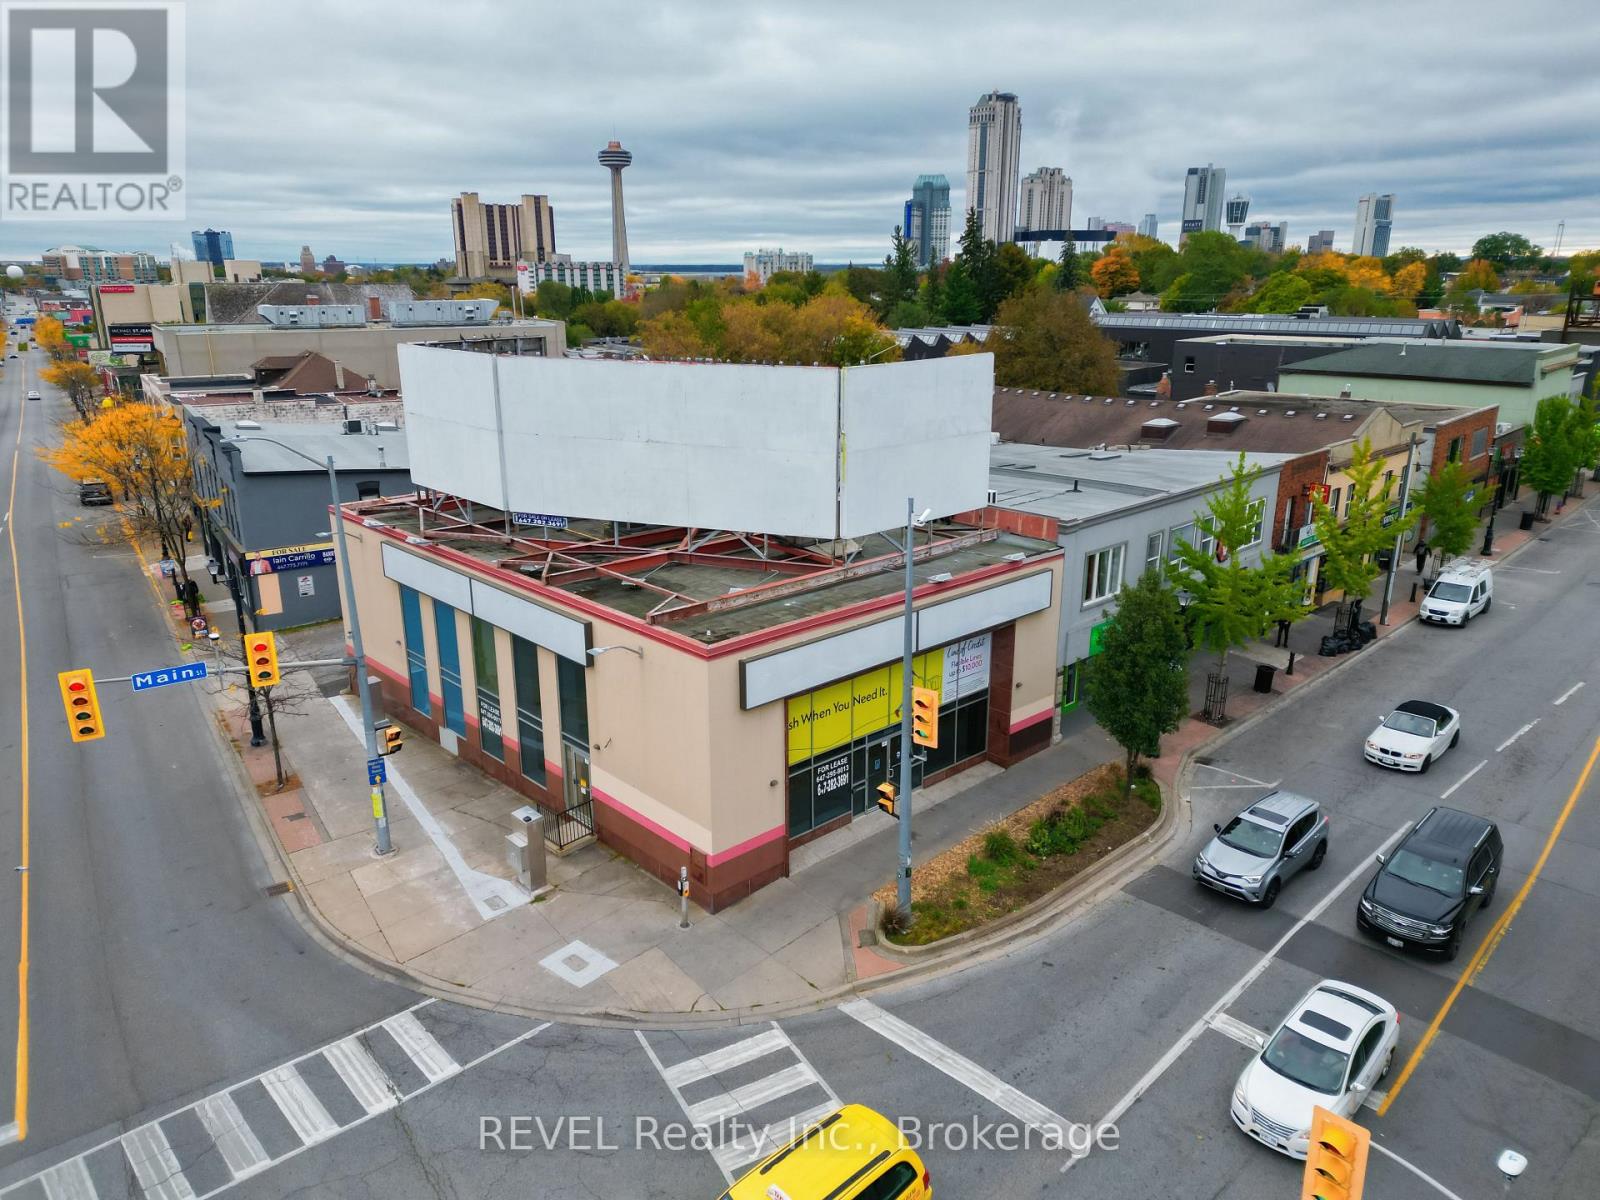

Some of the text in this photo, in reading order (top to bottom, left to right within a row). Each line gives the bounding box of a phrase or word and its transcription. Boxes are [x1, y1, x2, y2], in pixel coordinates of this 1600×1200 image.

[288, 552, 316, 561] Carrillo
[136, 669, 194, 687] Main
[801, 708, 831, 724] When
[833, 701, 850, 713] You
[852, 688, 877, 707] Need
[879, 686, 888, 697] It.
[818, 756, 848, 775] FOR LEASE
